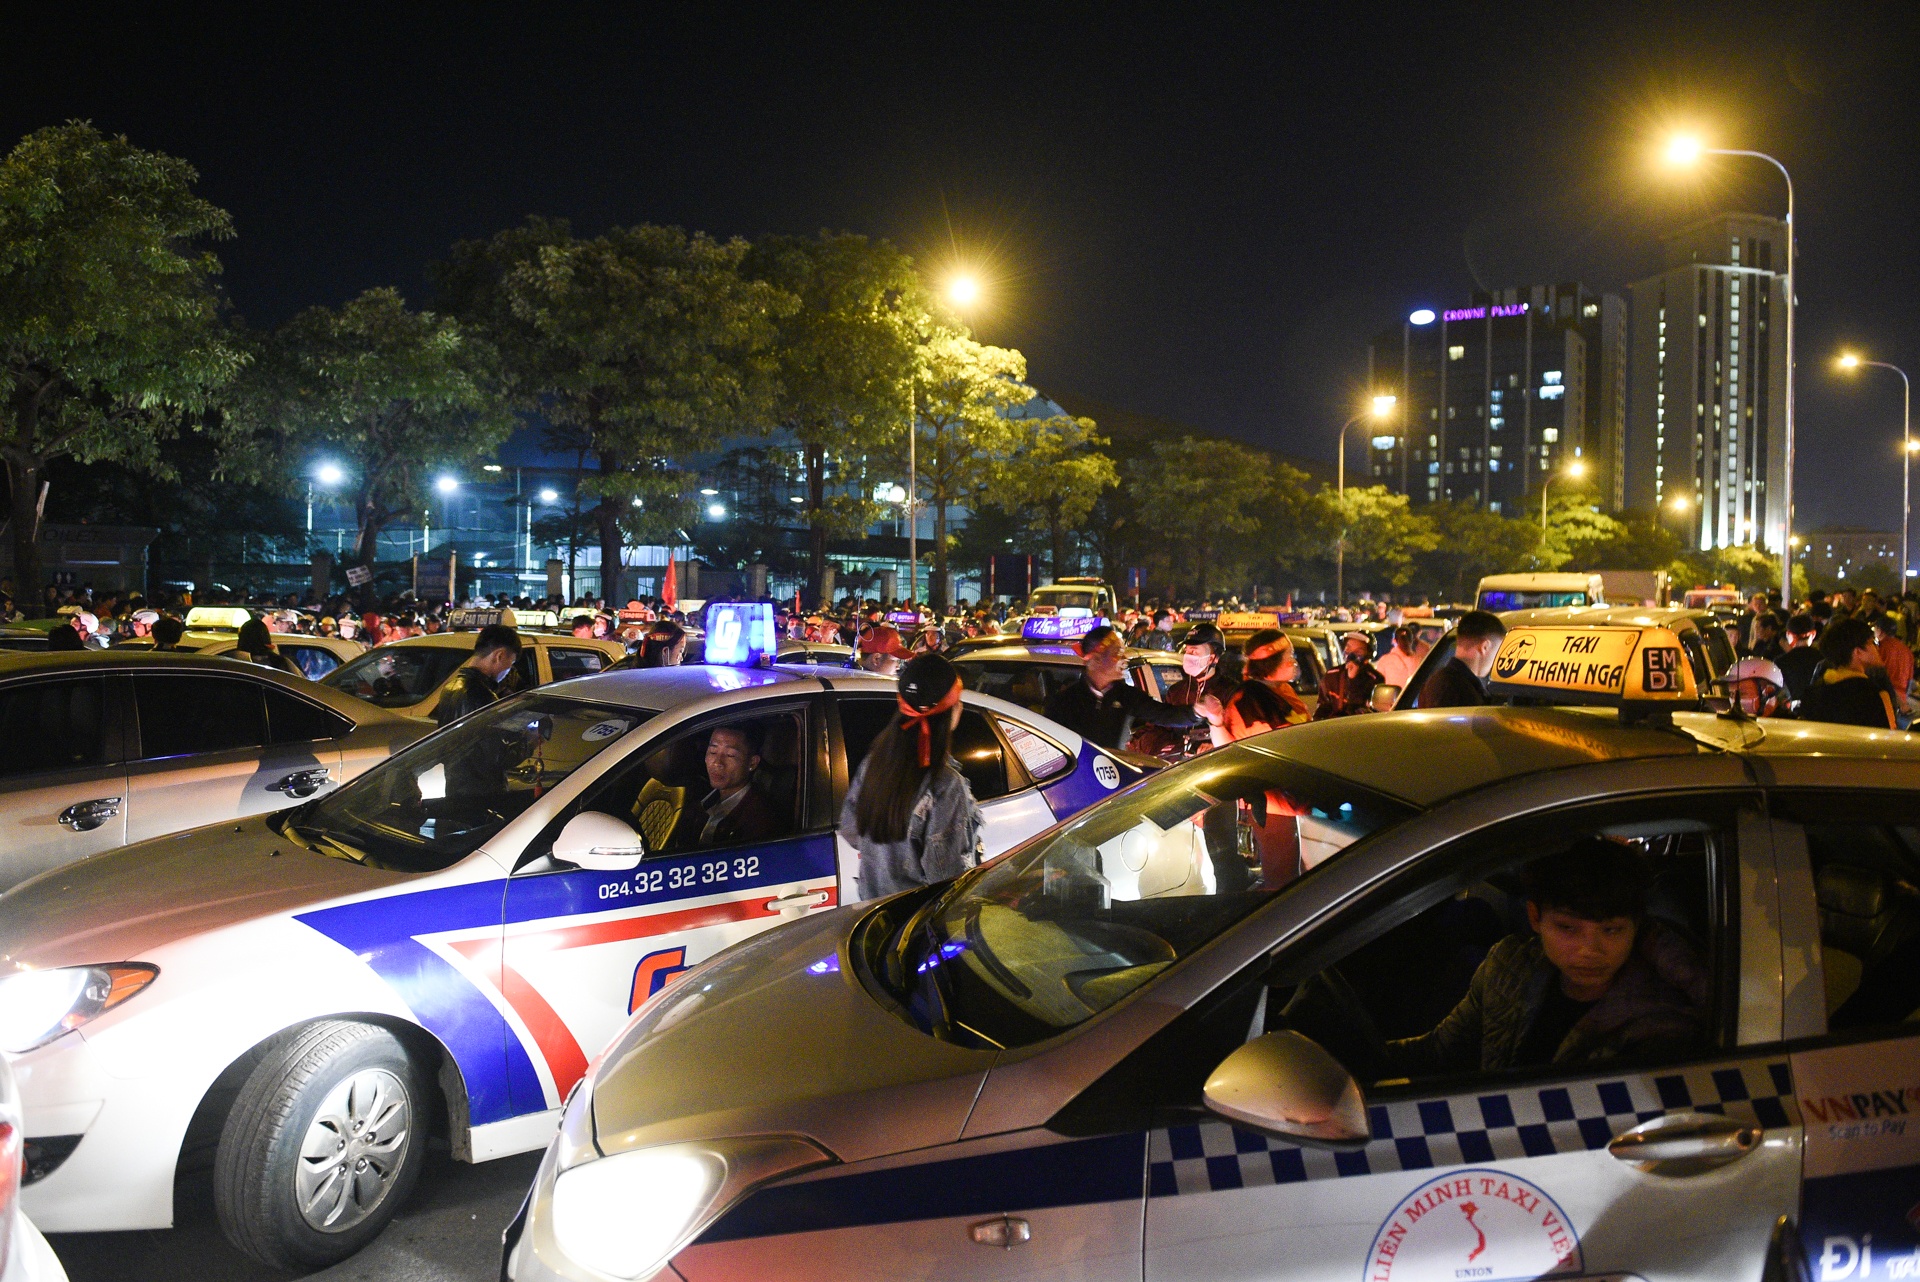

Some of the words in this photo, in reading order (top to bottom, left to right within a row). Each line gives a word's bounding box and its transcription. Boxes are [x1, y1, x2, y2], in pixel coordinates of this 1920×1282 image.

[1443, 307, 1486, 322] CROWNE
[1491, 304, 1525, 318] PLAZA
[1562, 636, 1600, 654] TAXI
[1648, 649, 1677, 670] EM
[1528, 660, 1581, 686] THANH
[1584, 664, 1624, 689] NGA
[590, 723, 619, 737] 1755
[1096, 765, 1117, 780] 1755
[668, 865, 696, 889] 32
[701, 861, 728, 884] 32
[733, 856, 760, 879] 32
[1404, 1178, 1473, 1224] MINH
[1480, 1178, 1542, 1215] TAXI
[1455, 1267, 1493, 1279] UNION
